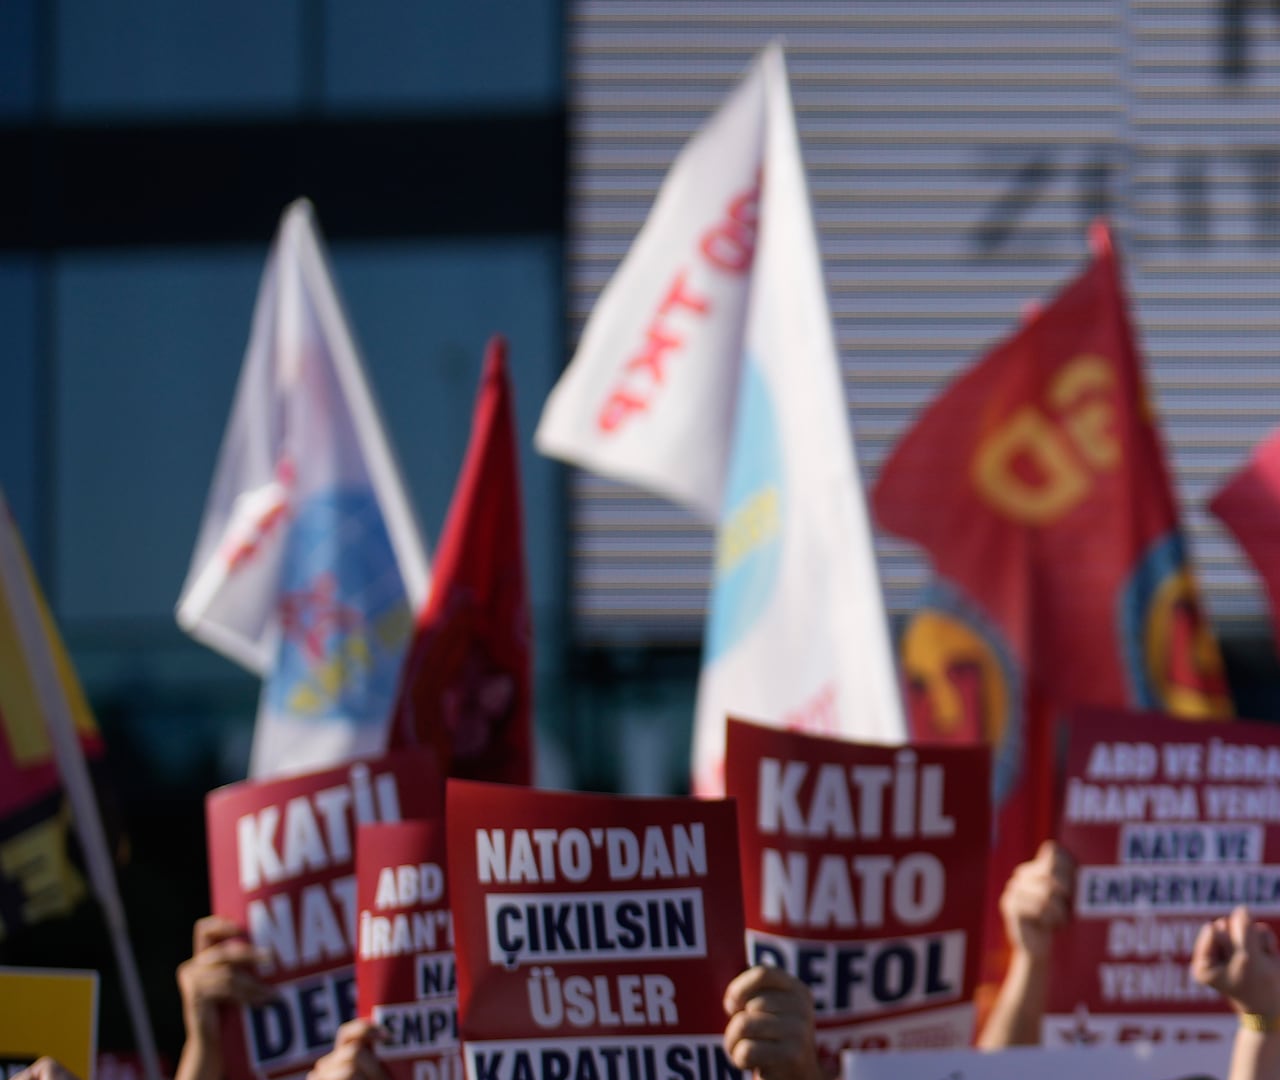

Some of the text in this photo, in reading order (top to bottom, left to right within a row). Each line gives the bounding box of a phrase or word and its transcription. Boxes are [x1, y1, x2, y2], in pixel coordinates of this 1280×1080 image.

[1086, 741, 1157, 780] ABD
[1162, 742, 1200, 779] VE
[757, 750, 955, 839] KATİL
[476, 824, 707, 884] NATO'DAN
[1126, 830, 1250, 860] NATO VE
[374, 862, 444, 911] ABD
[761, 850, 947, 928] NATO
[496, 898, 699, 970] ÇIKILSIN
[526, 968, 678, 1029] ÜSLER
